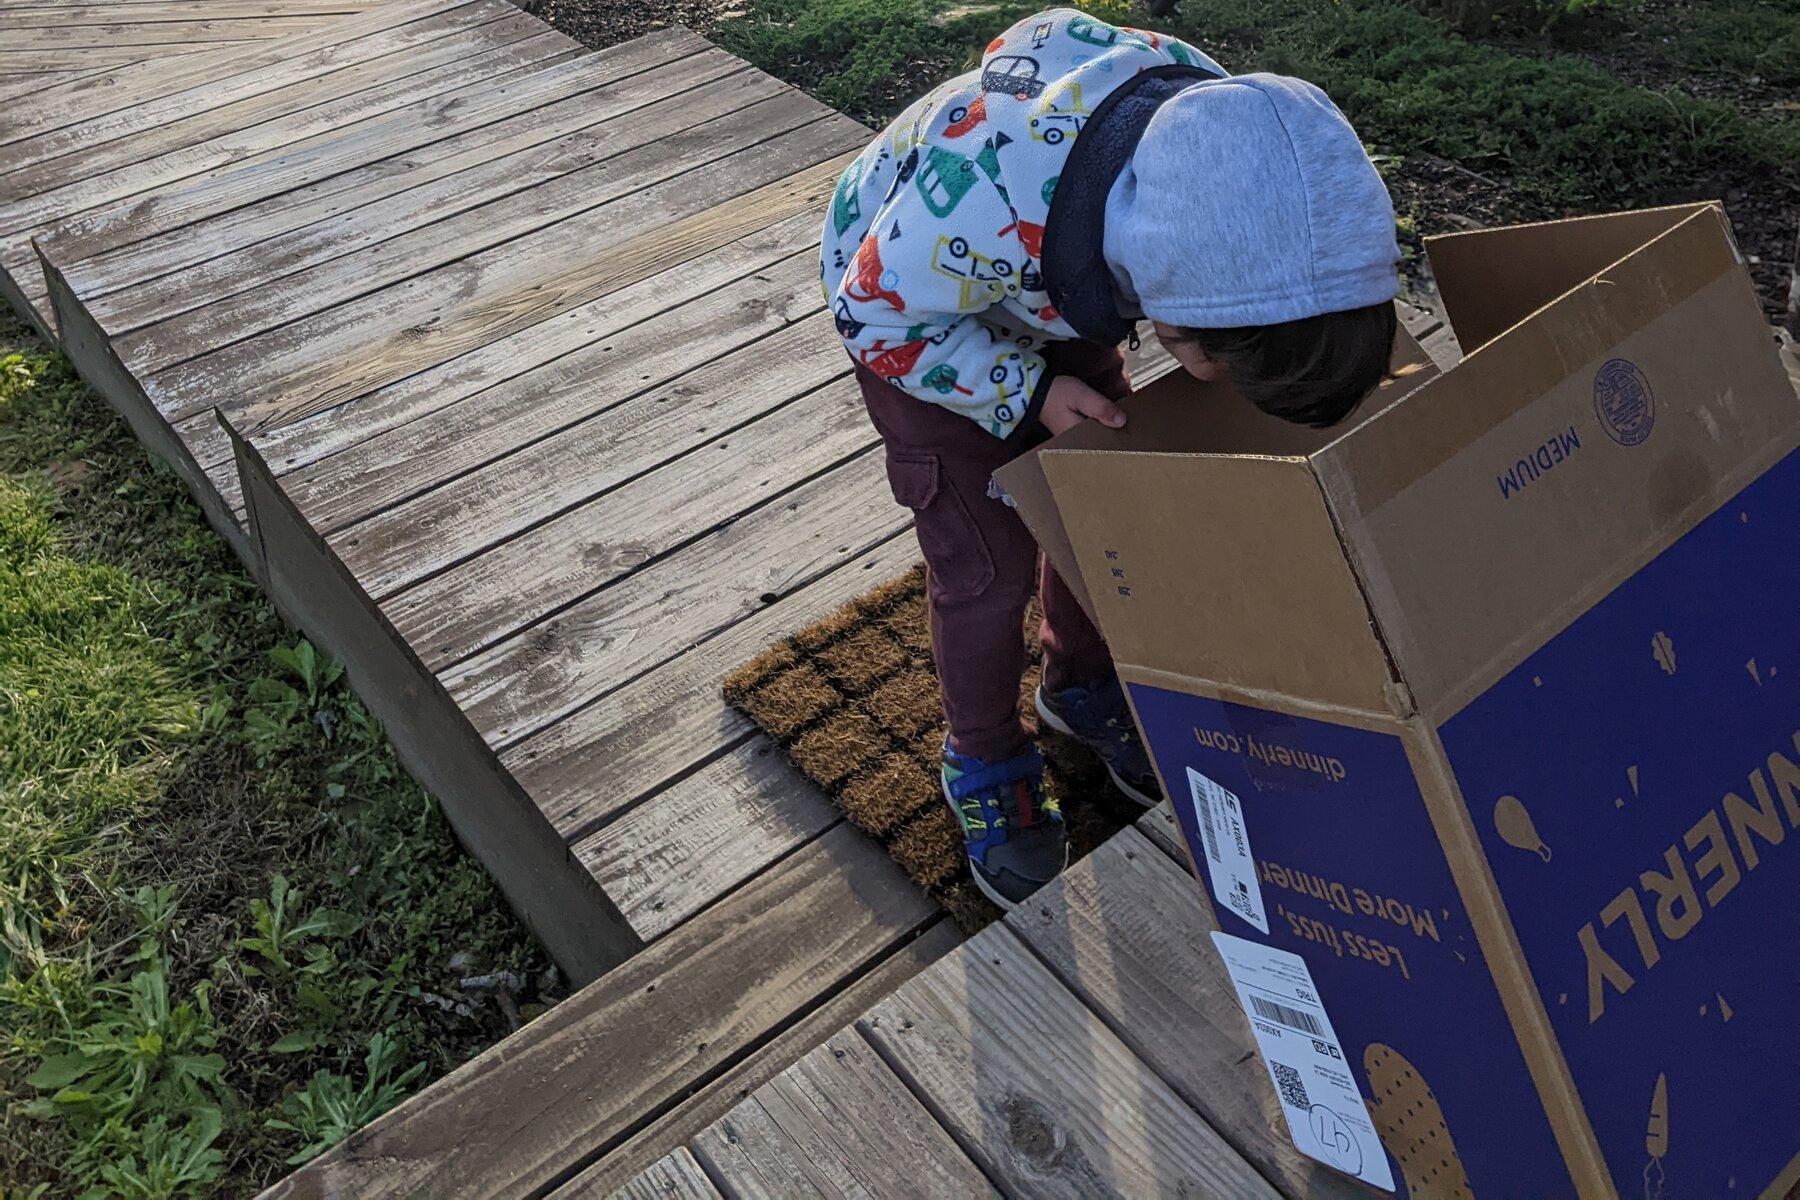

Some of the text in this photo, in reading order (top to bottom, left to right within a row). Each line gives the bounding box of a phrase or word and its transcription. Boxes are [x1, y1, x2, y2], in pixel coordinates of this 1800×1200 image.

[1497, 426, 1581, 499] MEDIUM
[1193, 726, 1346, 782] dinnerly.com
[1277, 903, 1410, 980] Less fuss,
[1353, 888, 1440, 942] More
